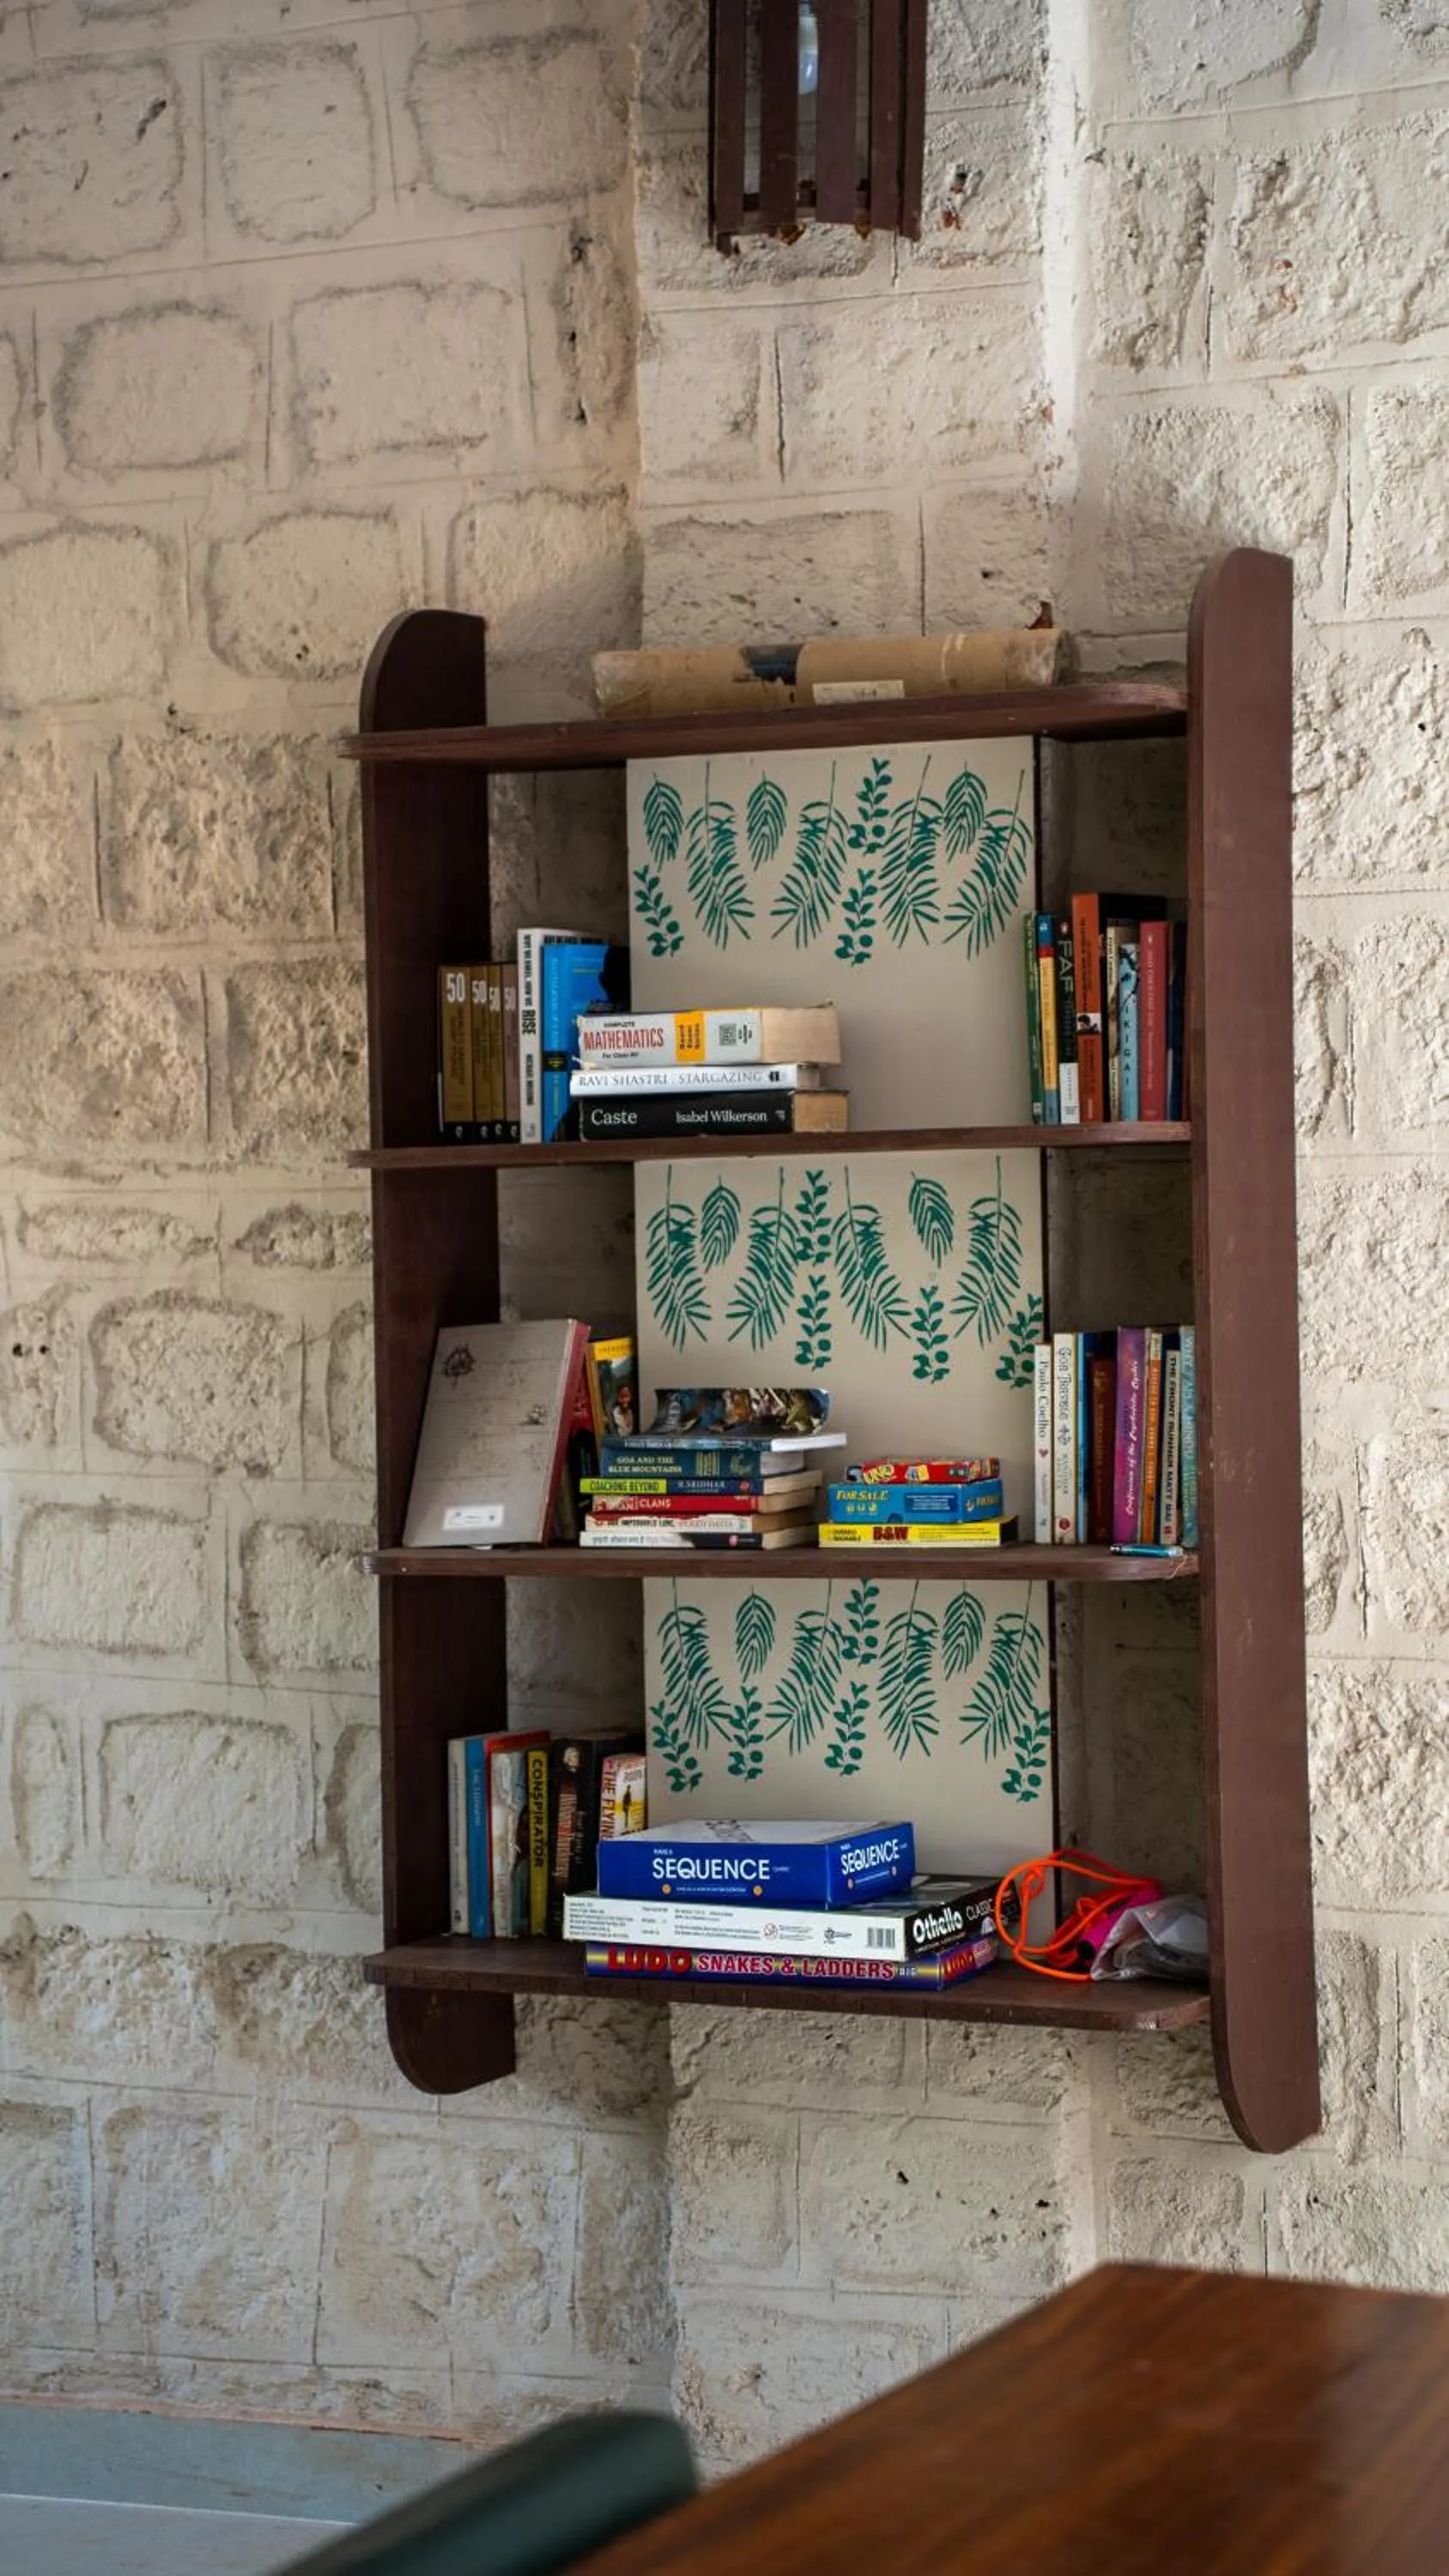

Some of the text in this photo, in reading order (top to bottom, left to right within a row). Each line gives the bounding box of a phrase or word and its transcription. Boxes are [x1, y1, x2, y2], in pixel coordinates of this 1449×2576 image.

[446, 973, 465, 1003] 50
[471, 980, 487, 1004] 50
[488, 987, 500, 1012] 50
[504, 987, 516, 1010] 50
[522, 1010, 537, 1035] RISE
[583, 1028, 664, 1051] MATHEMATICS
[579, 1072, 763, 1086] RAVI SHASTRI STARGAZING
[591, 1109, 767, 1126] Caste Isabel Wilkerson
[1185, 1336, 1194, 1367] WHY
[1168, 1358, 1177, 1377] THE
[1038, 1361, 1049, 1439] Paulo Coelho
[1167, 1421, 1175, 1469] RUNNER
[1185, 1415, 1194, 1460] HINDU
[633, 1465, 682, 1473] MOUNTAINS
[658, 1455, 674, 1464] THE
[590, 1480, 660, 1492] COACHING BEYOND
[864, 1464, 895, 1484] UNO
[640, 1498, 671, 1509] CLANS
[835, 1490, 890, 1501] FOR SALE
[603, 1771, 615, 1795] THE
[530, 1759, 544, 1868] CONSPIRATOR
[652, 1857, 770, 1880] SEQUENCE
[840, 1838, 900, 1875] SEQUENCE
[912, 1905, 963, 1943] Othello
[607, 1947, 693, 1974] LUDO
[698, 1953, 773, 1973] SNAKES
[781, 1958, 795, 1975] &
[801, 1959, 894, 1978] LADDERS
